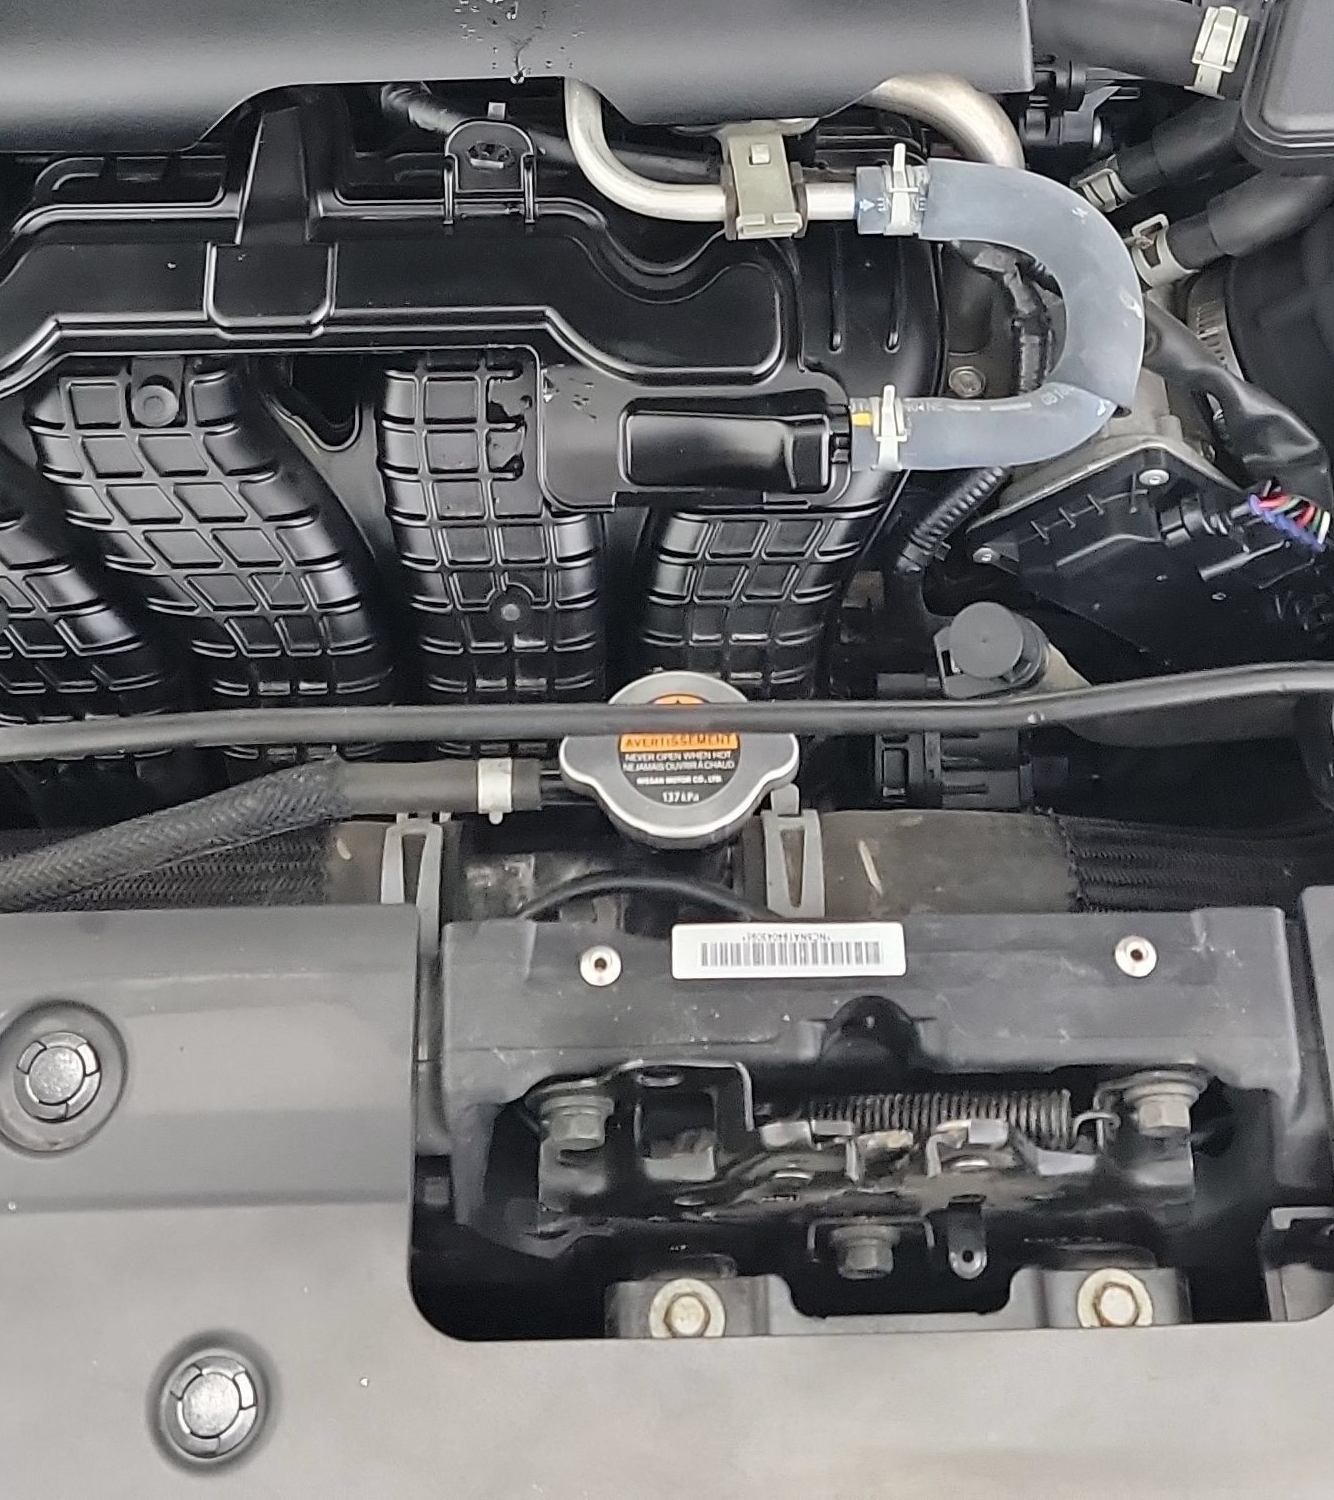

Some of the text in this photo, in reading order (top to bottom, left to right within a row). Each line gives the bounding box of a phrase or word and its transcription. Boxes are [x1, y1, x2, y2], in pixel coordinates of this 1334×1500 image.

[626, 734, 731, 747] AVERTISSEMENT
[625, 751, 731, 761] NEVER OPEN WHEN HOT
[634, 762, 664, 771] JAMAIS
[705, 760, 735, 769] CHAUD
